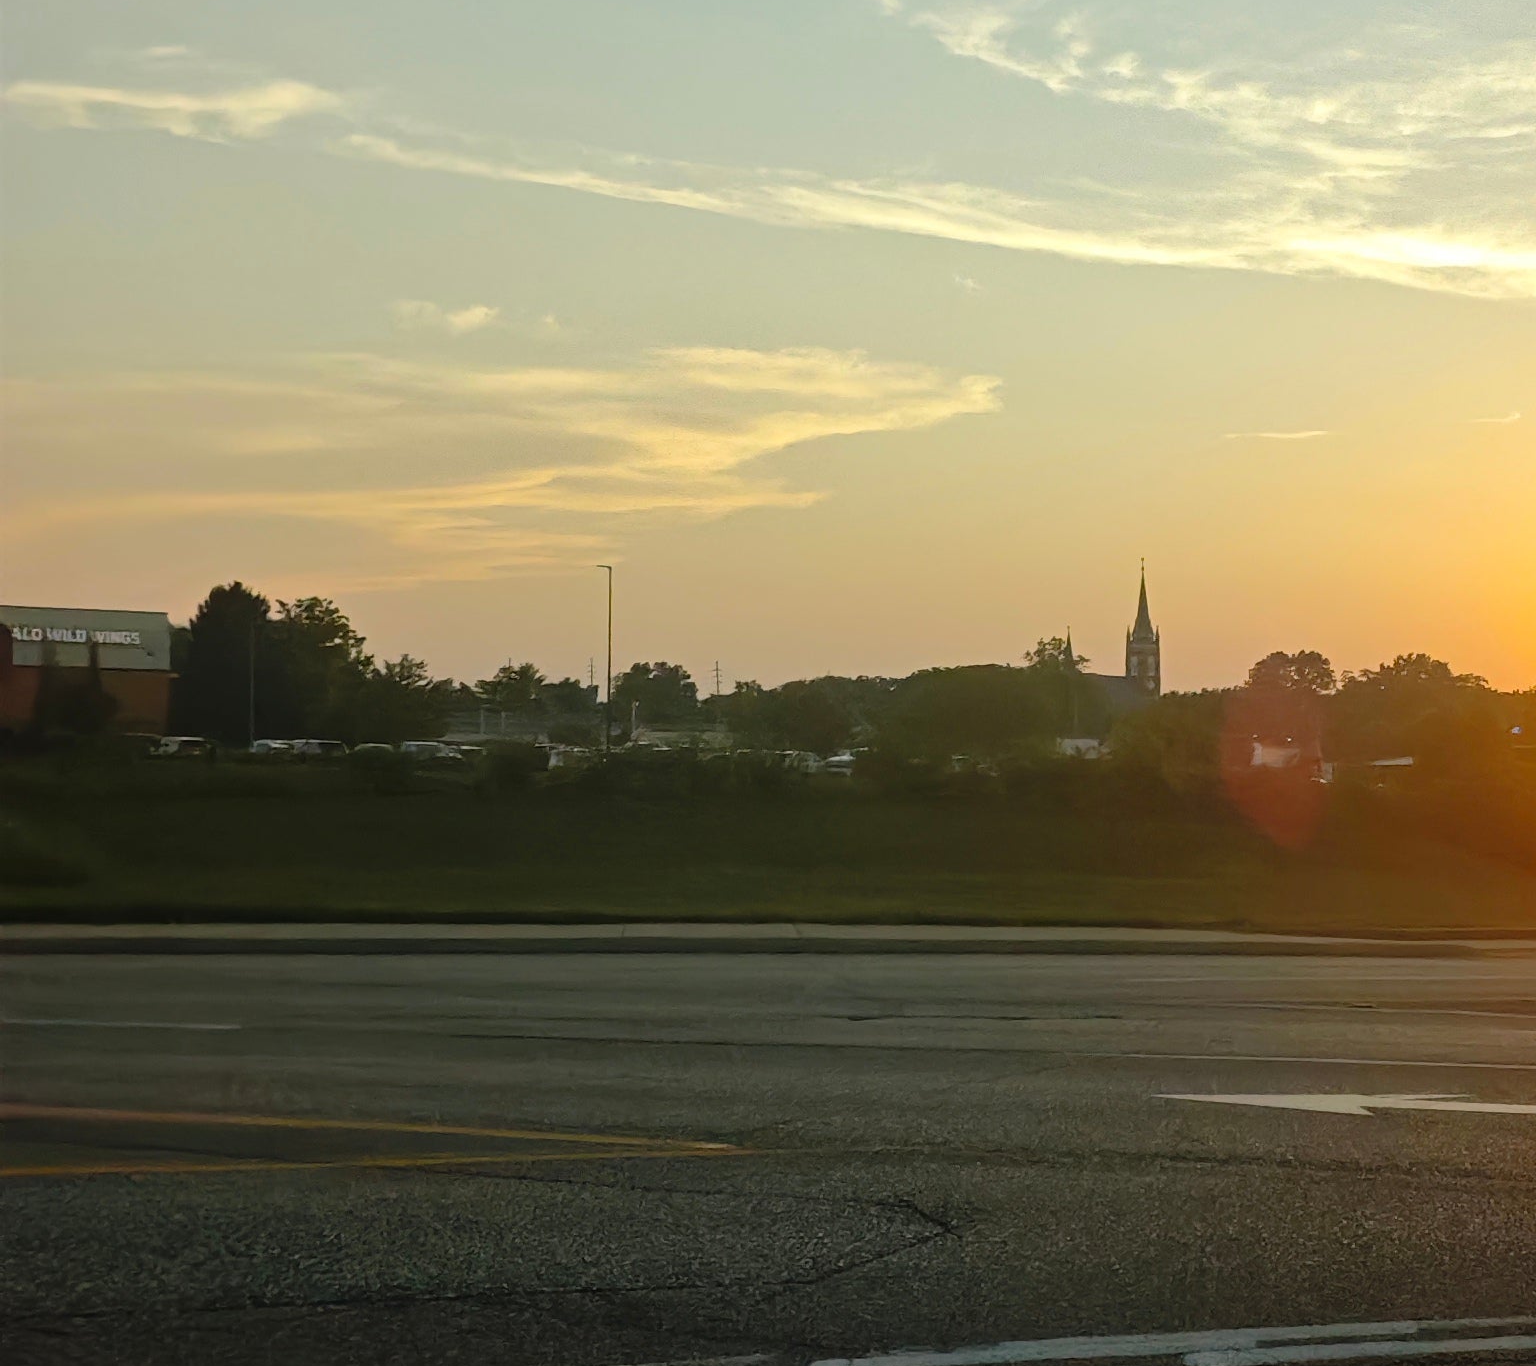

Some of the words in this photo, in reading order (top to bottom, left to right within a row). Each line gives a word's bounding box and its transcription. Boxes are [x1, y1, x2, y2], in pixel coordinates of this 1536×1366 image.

[11, 626, 44, 641] ALO
[46, 628, 88, 643] WILD
[91, 631, 141, 645] WINGS
